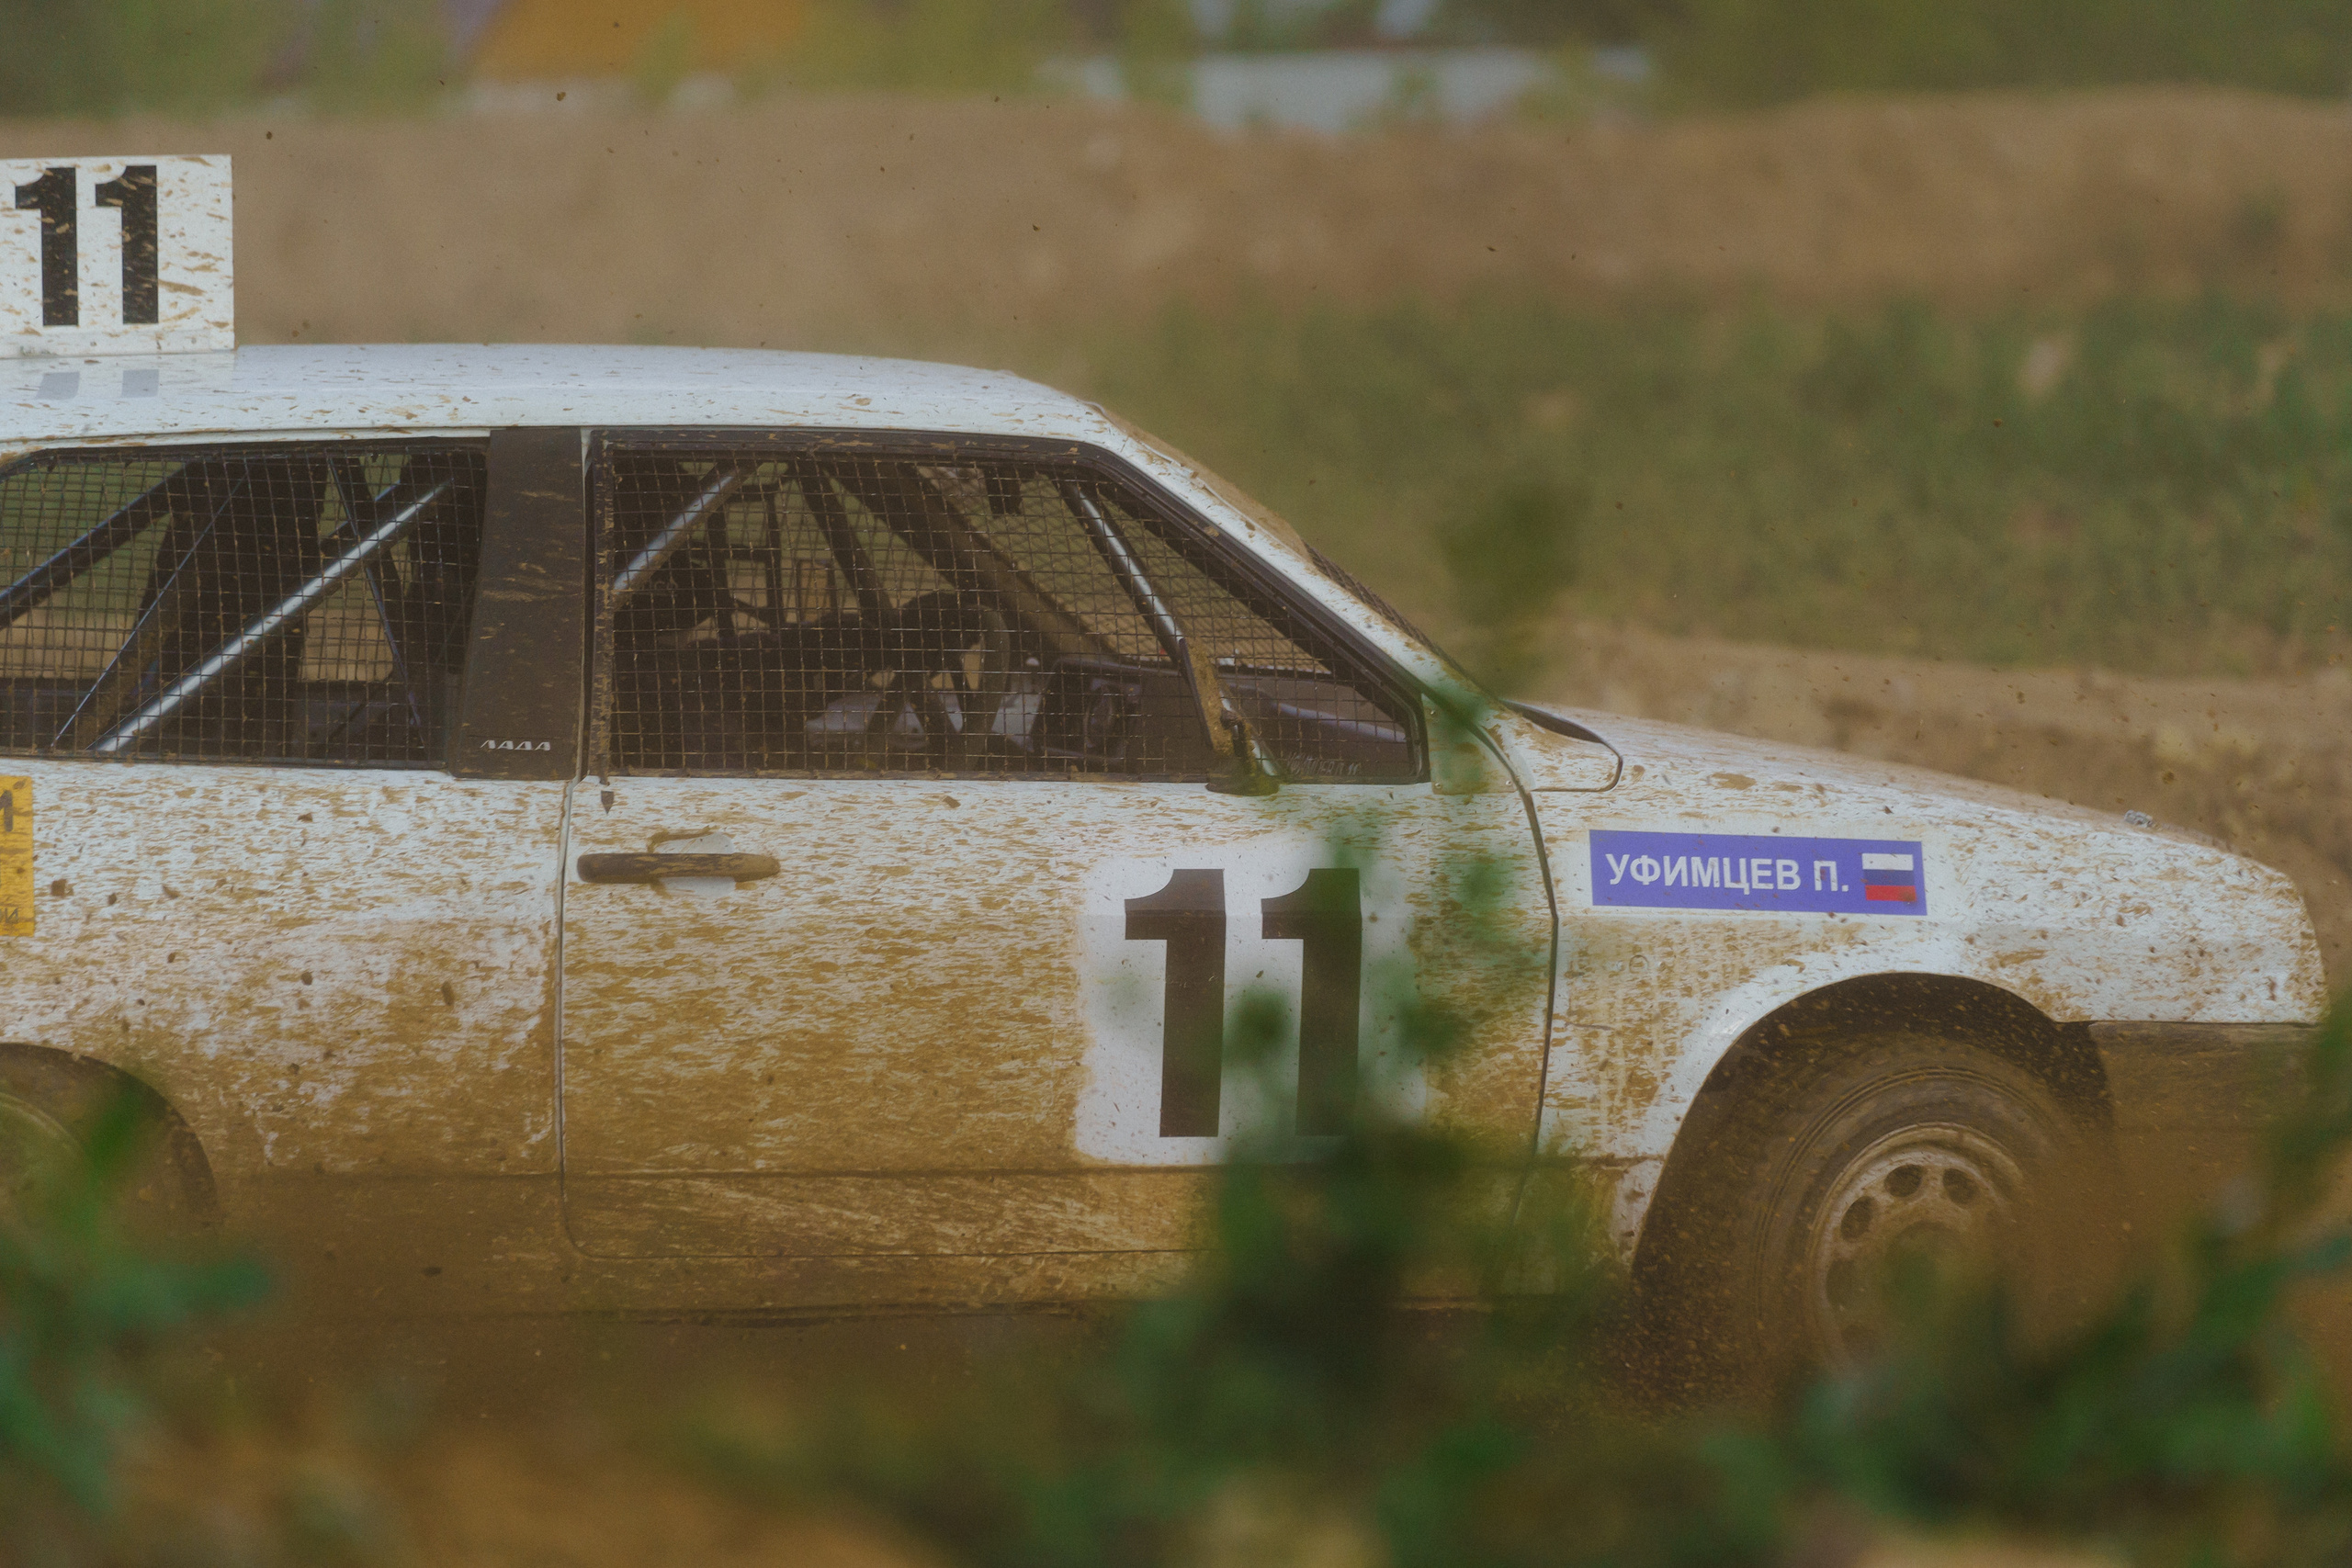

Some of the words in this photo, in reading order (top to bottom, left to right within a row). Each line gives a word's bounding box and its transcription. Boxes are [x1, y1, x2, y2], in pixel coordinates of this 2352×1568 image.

[15, 164, 159, 326] 11
[1605, 852, 1802, 896] УФИМЦЕВ
[1813, 860, 1849, 893] П.
[1124, 867, 1363, 1137] 11
